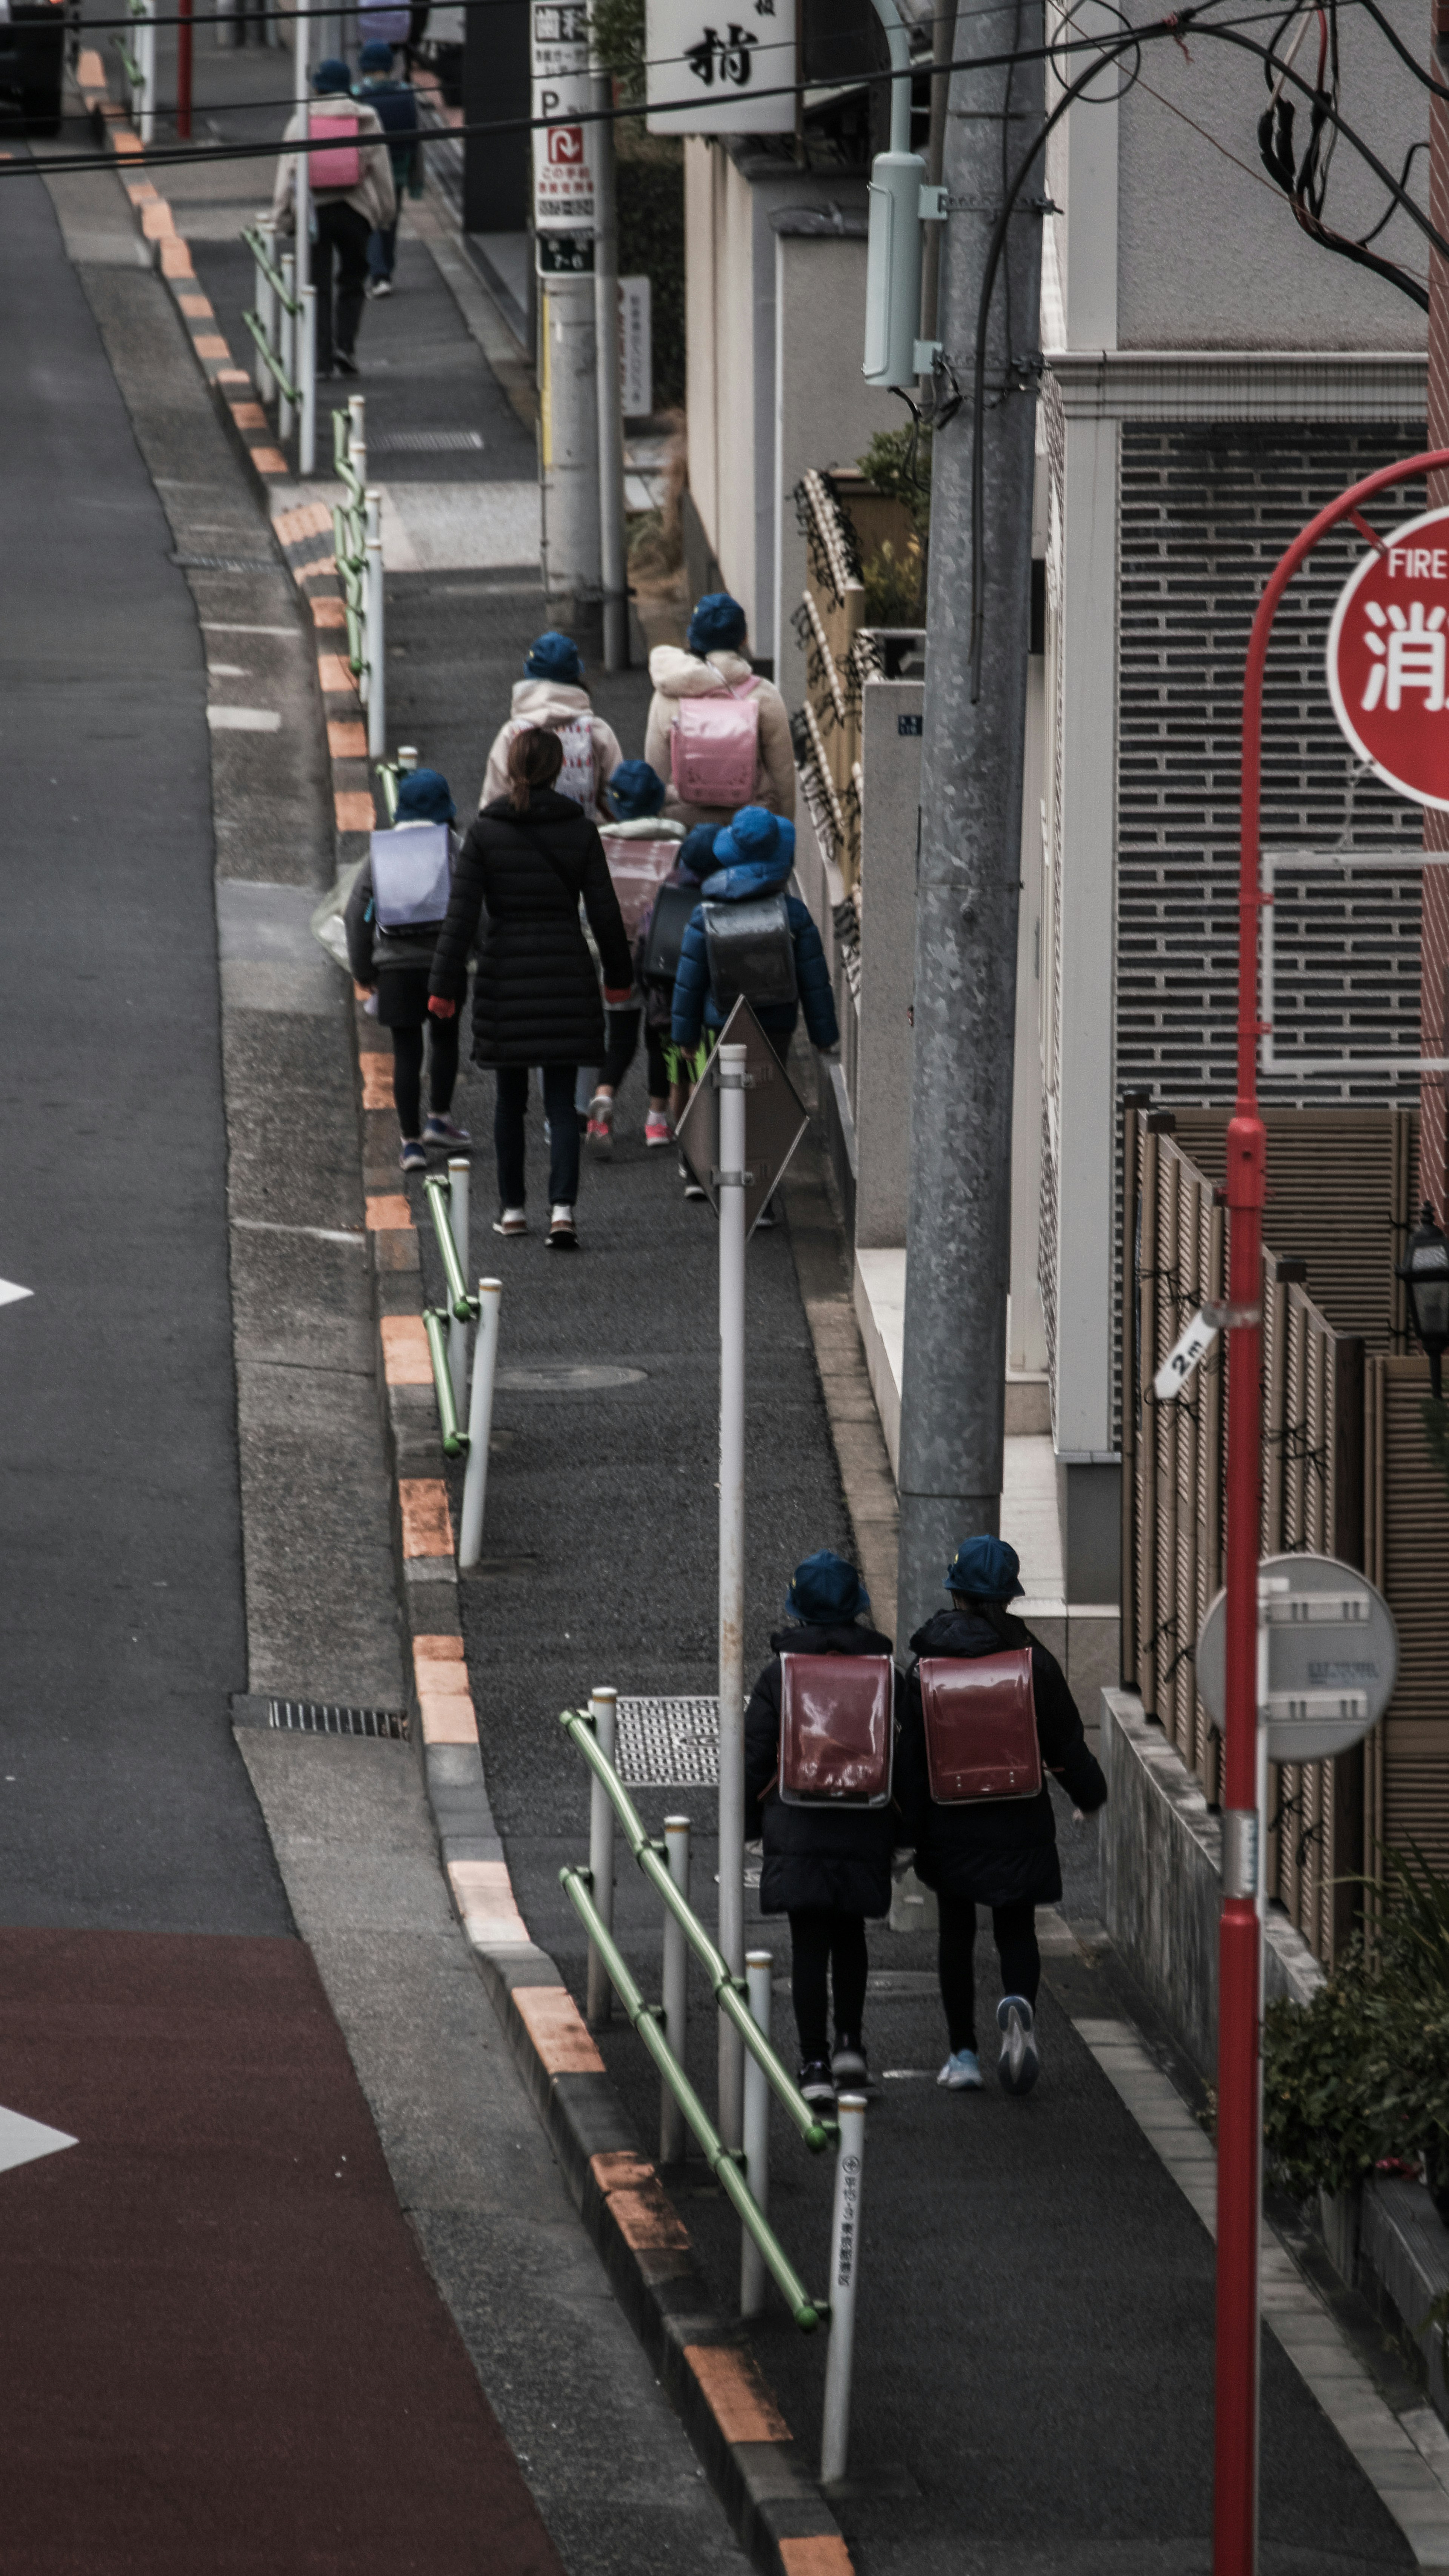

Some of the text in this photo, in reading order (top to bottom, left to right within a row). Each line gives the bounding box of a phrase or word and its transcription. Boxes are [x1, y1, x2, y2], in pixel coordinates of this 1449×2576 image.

[542, 91, 559, 118] P
[1387, 549, 1448, 579] FIRE
[1361, 601, 1449, 712] 消
[1171, 1340, 1203, 1376] 2m
